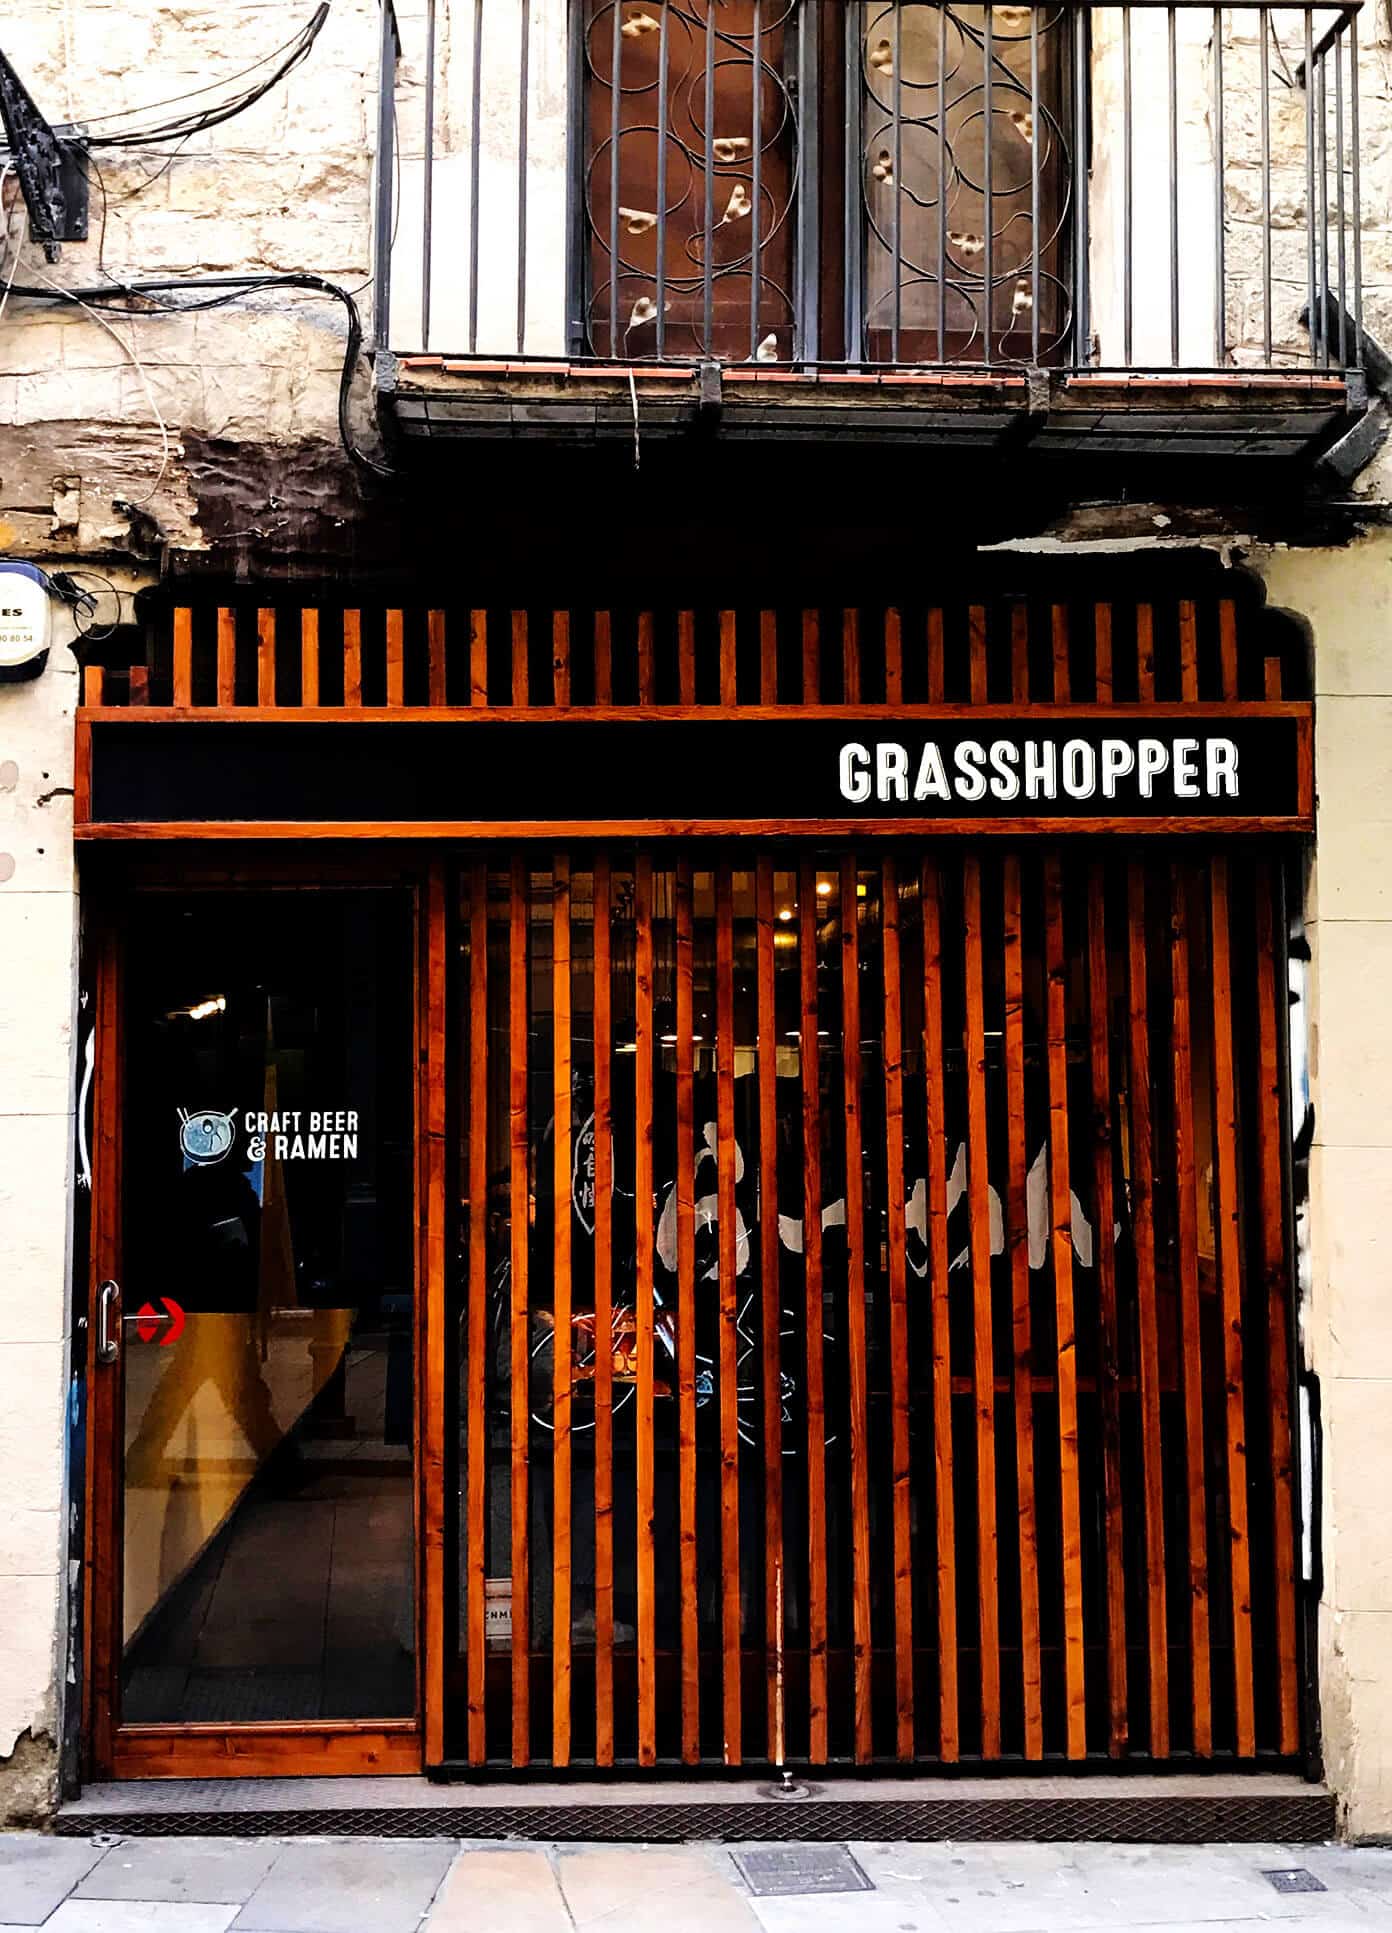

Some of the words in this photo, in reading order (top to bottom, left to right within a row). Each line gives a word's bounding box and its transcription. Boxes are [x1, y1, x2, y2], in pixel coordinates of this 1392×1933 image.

[839, 738, 1239, 802] GRASSHOPPER
[245, 1111, 301, 1133] CRAFT
[310, 1110, 359, 1132] BEER
[246, 1136, 267, 1162] &
[274, 1134, 358, 1160] RAMEN
